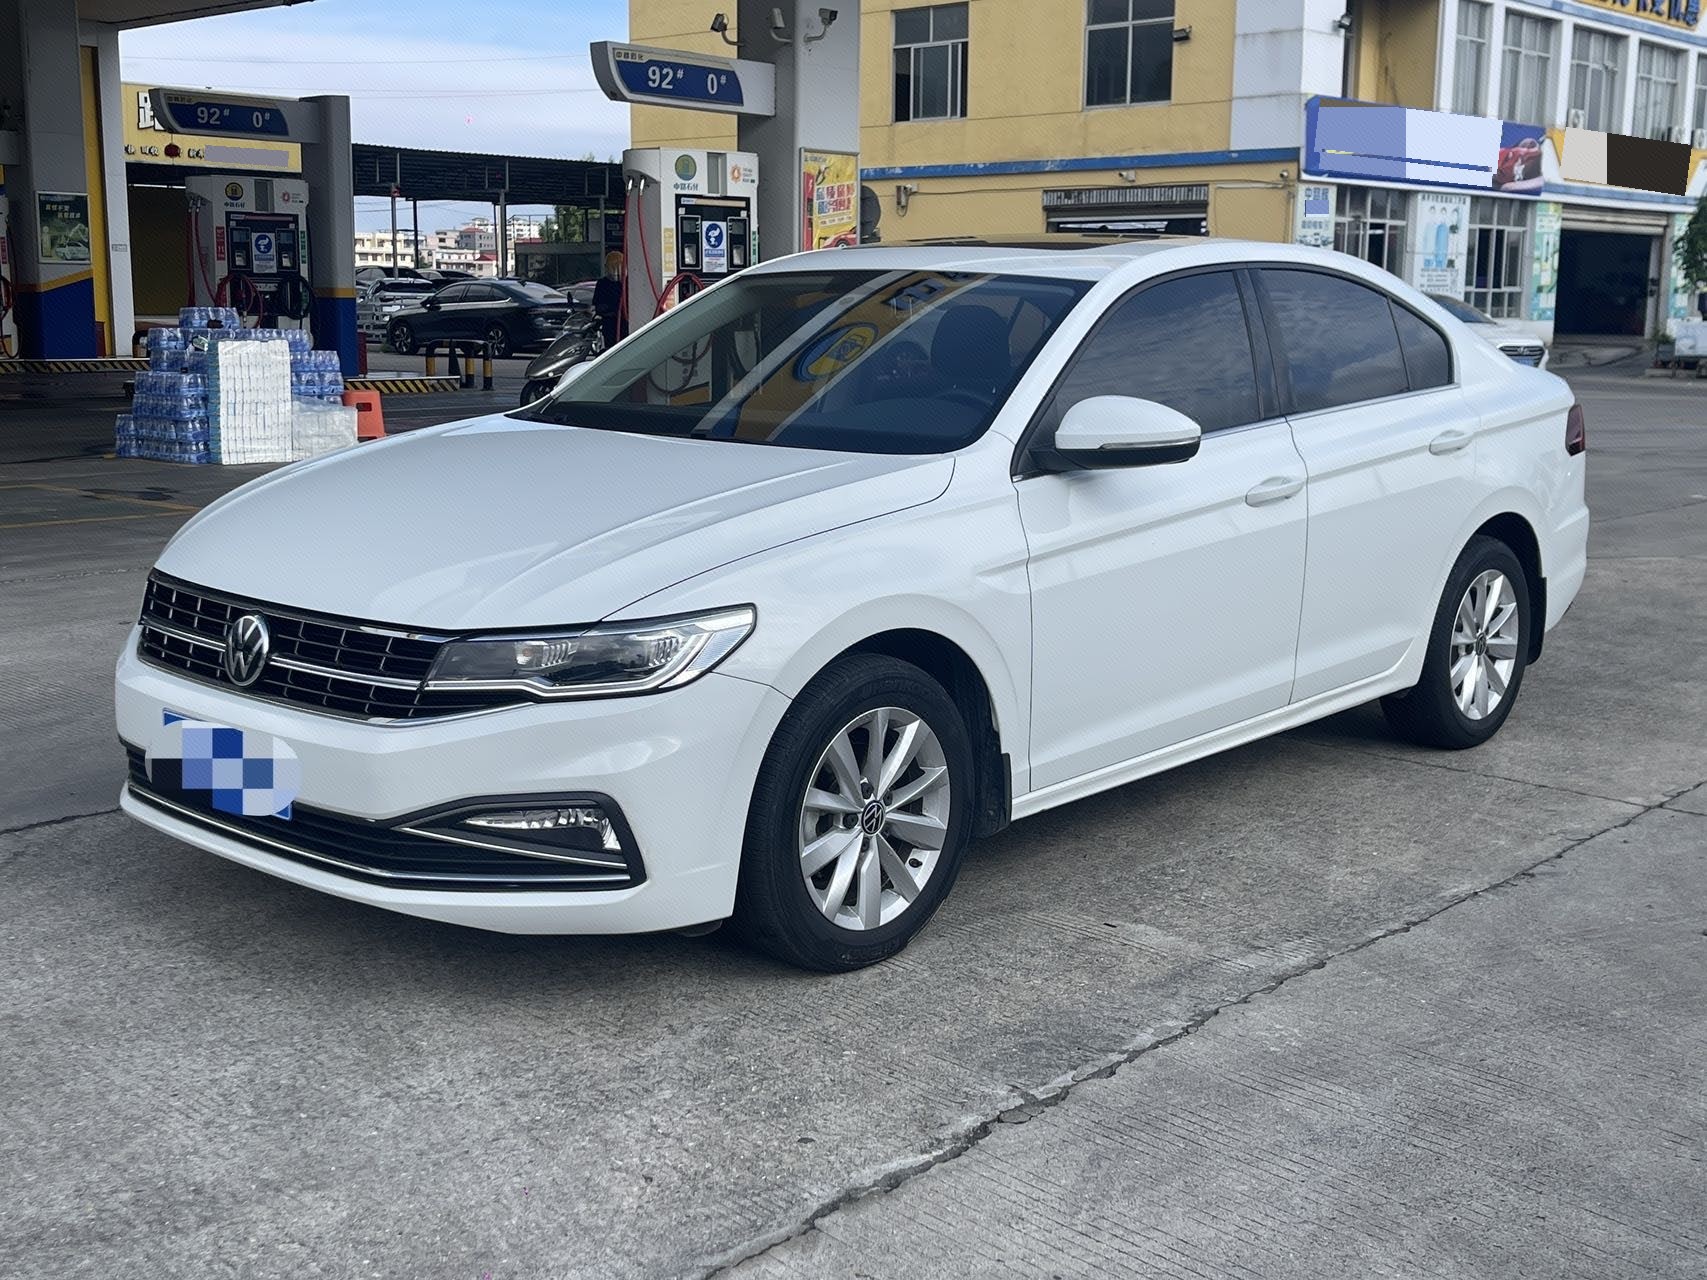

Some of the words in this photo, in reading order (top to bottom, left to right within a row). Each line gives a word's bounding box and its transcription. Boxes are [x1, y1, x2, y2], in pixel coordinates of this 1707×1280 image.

[647, 66, 684, 90] 92#
[707, 73, 727, 95] 0#
[196, 107, 230, 125] 92#
[252, 111, 270, 128] 0#
